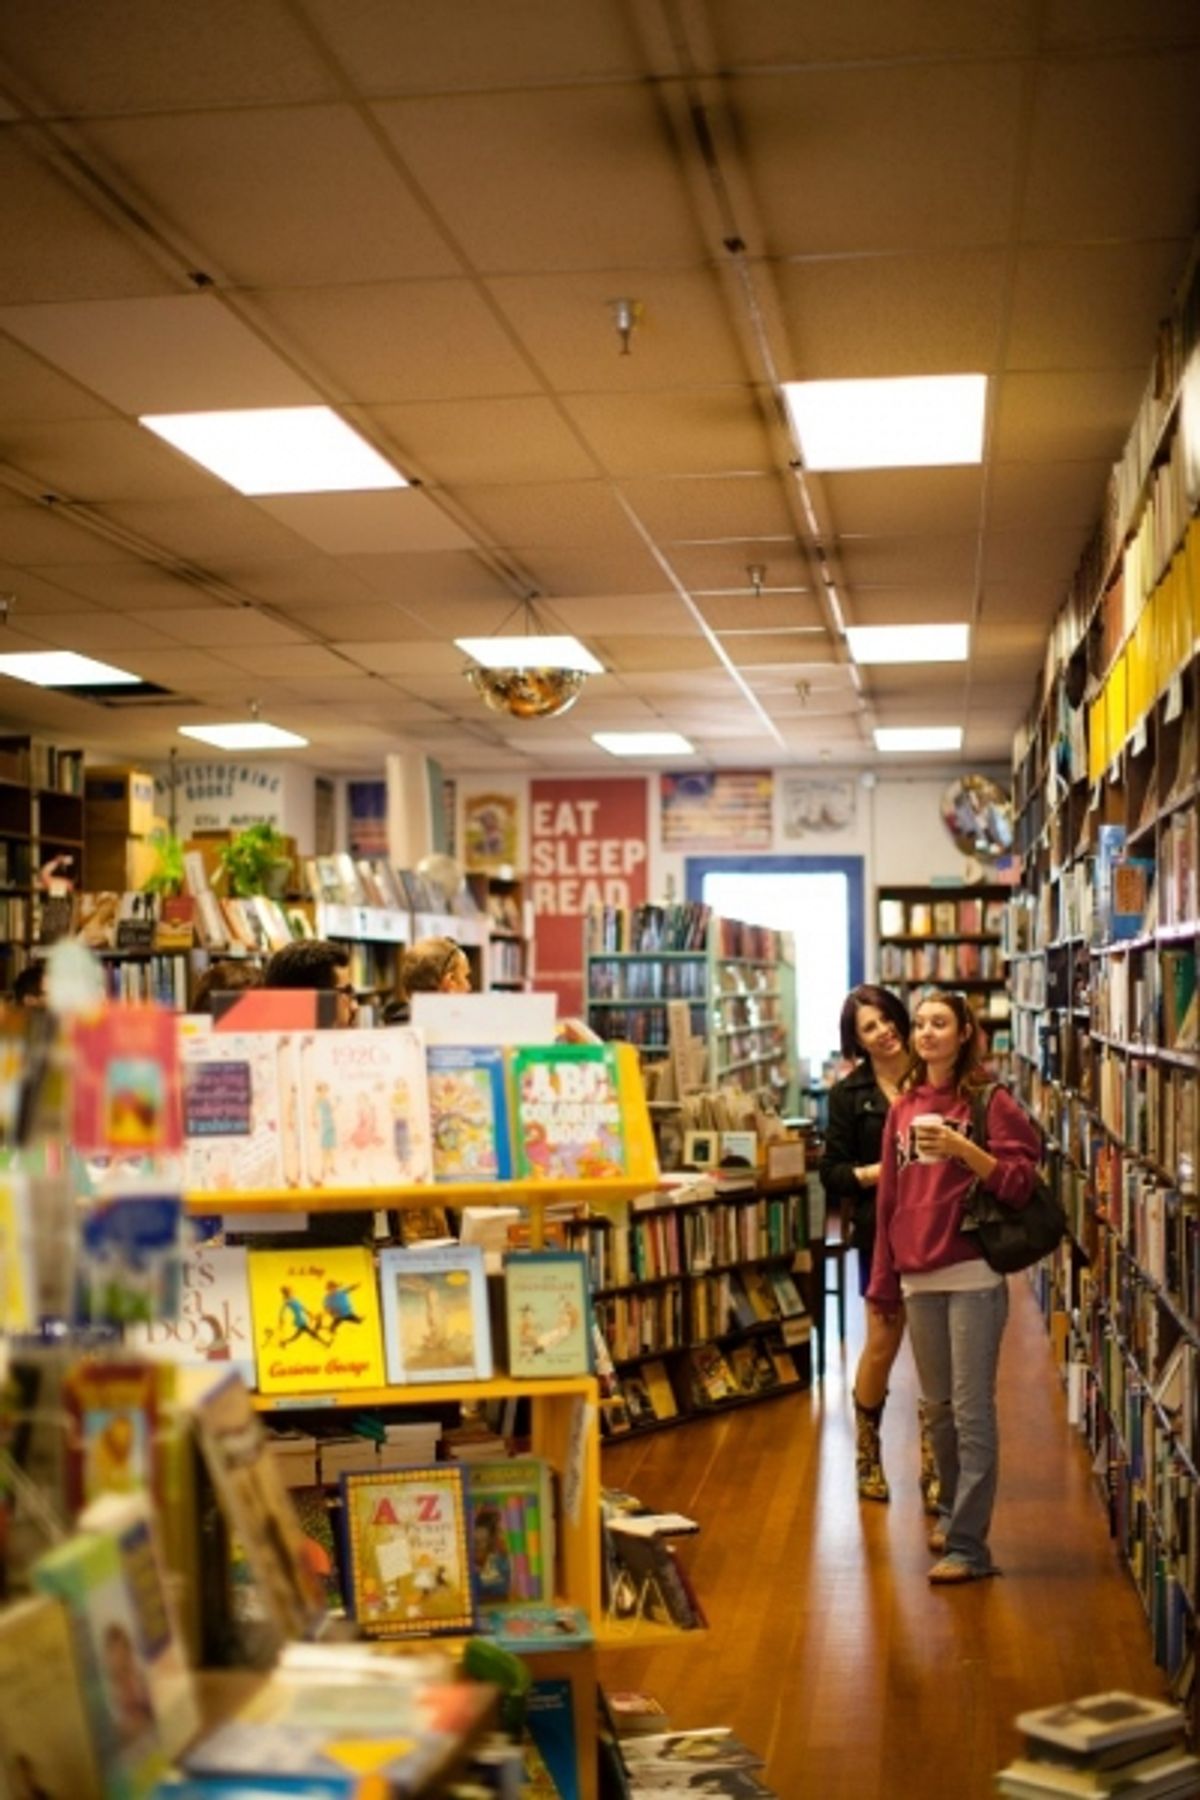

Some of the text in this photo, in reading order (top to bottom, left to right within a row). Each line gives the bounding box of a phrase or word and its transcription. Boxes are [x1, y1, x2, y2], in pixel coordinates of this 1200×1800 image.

[533, 800, 599, 836] EAT
[533, 839, 645, 876] SLEEP
[533, 879, 630, 917] READ
[373, 1494, 441, 1525] A Z
